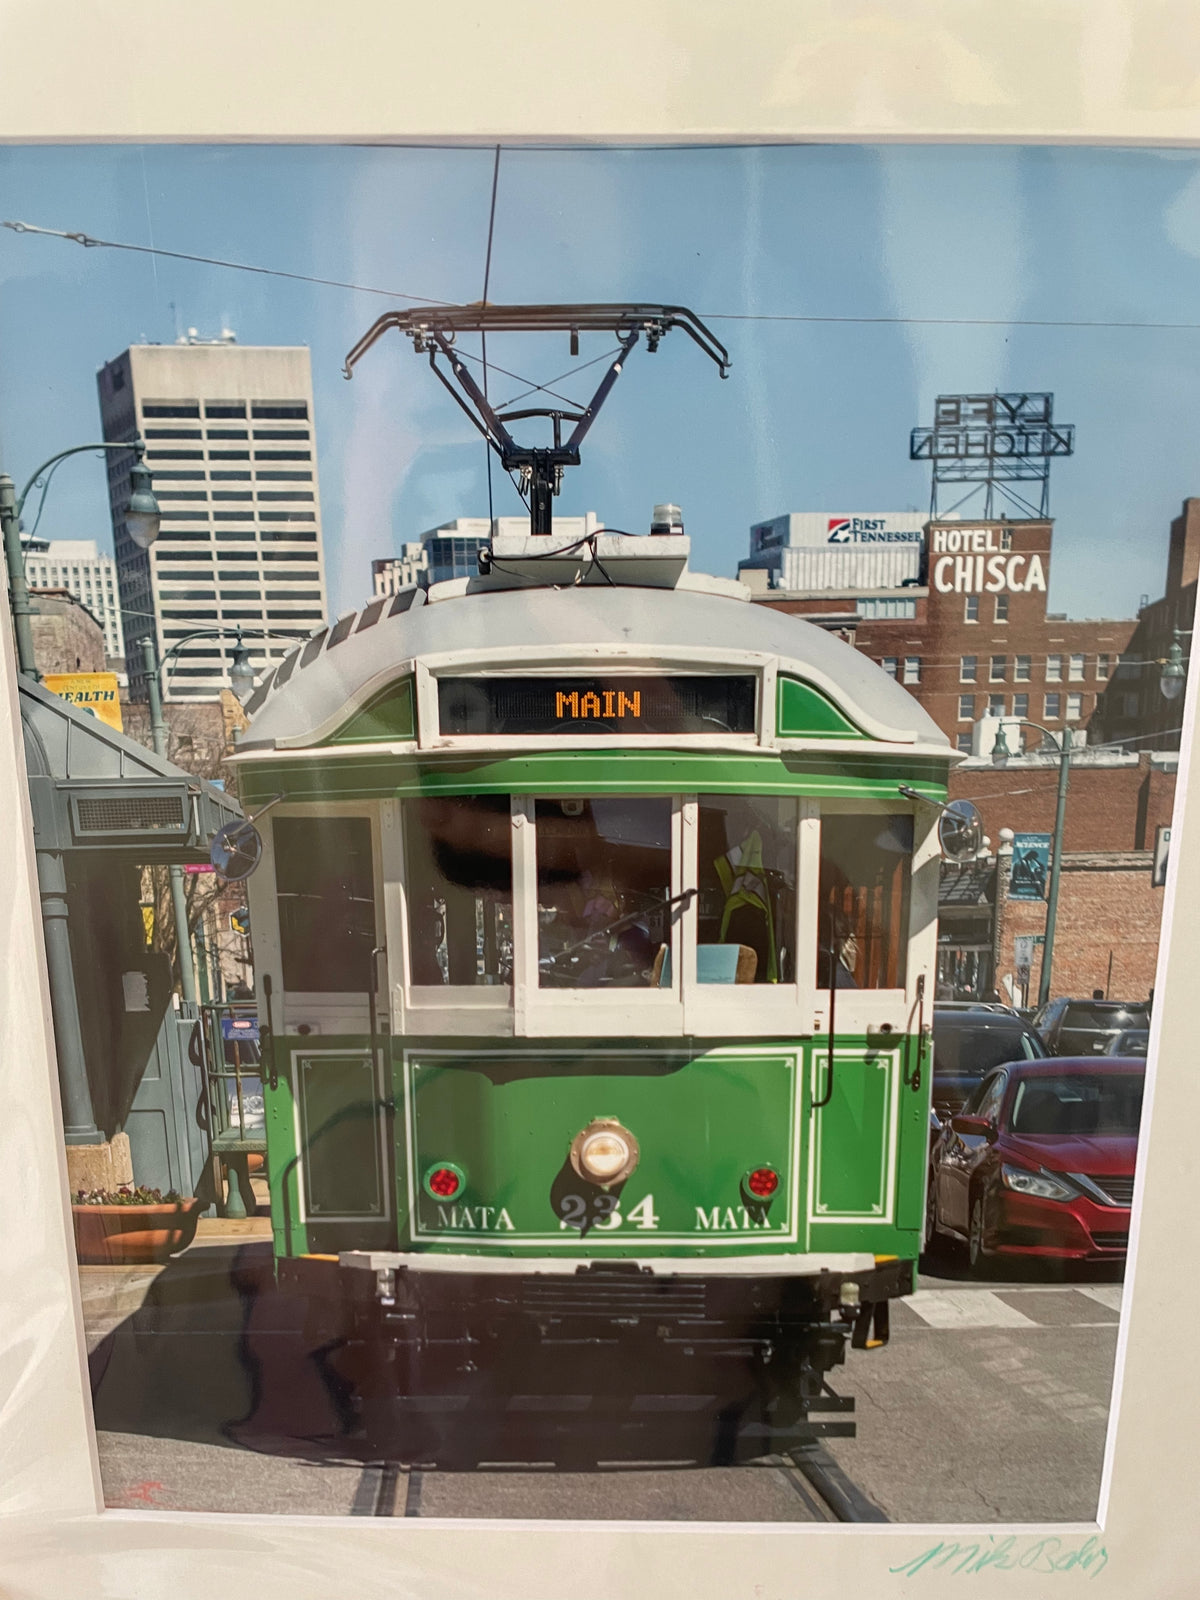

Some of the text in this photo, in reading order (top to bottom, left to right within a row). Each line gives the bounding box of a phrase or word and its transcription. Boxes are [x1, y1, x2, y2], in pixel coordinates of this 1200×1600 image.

[848, 530, 921, 542] TENNESSEE
[852, 518, 886, 530] FIRST
[934, 529, 998, 552] HOTEL
[934, 554, 1047, 593] CHISCA
[555, 691, 640, 718] MAIN
[437, 1205, 516, 1230] MATA
[560, 1194, 660, 1230] 234
[694, 1207, 772, 1230] MATA
